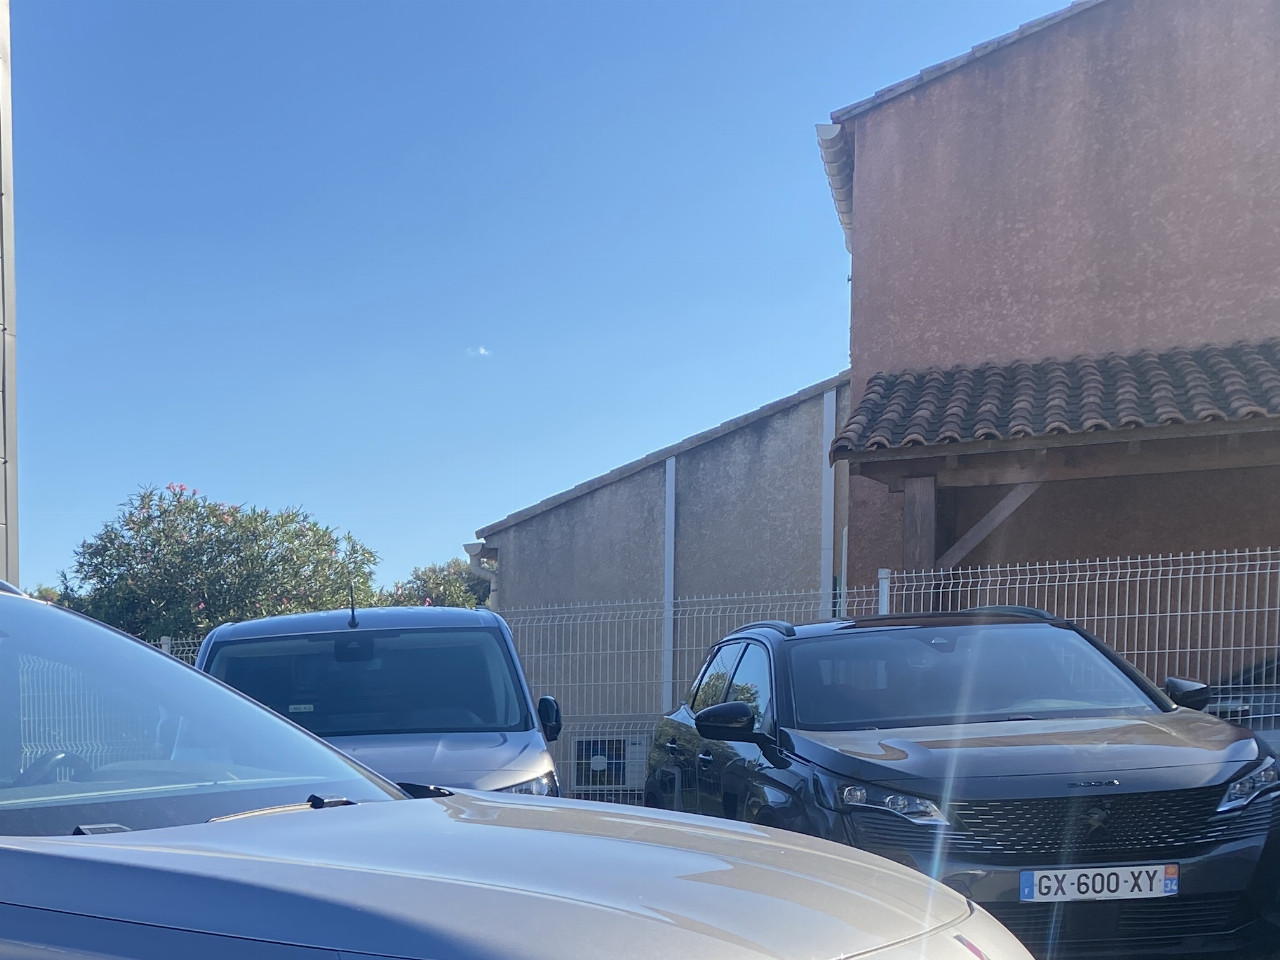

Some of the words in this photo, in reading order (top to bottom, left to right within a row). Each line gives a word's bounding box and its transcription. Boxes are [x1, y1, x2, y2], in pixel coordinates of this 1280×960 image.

[1024, 887, 1030, 895] F
[1038, 870, 1158, 896] GX-600-XY
[1164, 880, 1177, 891] 34
